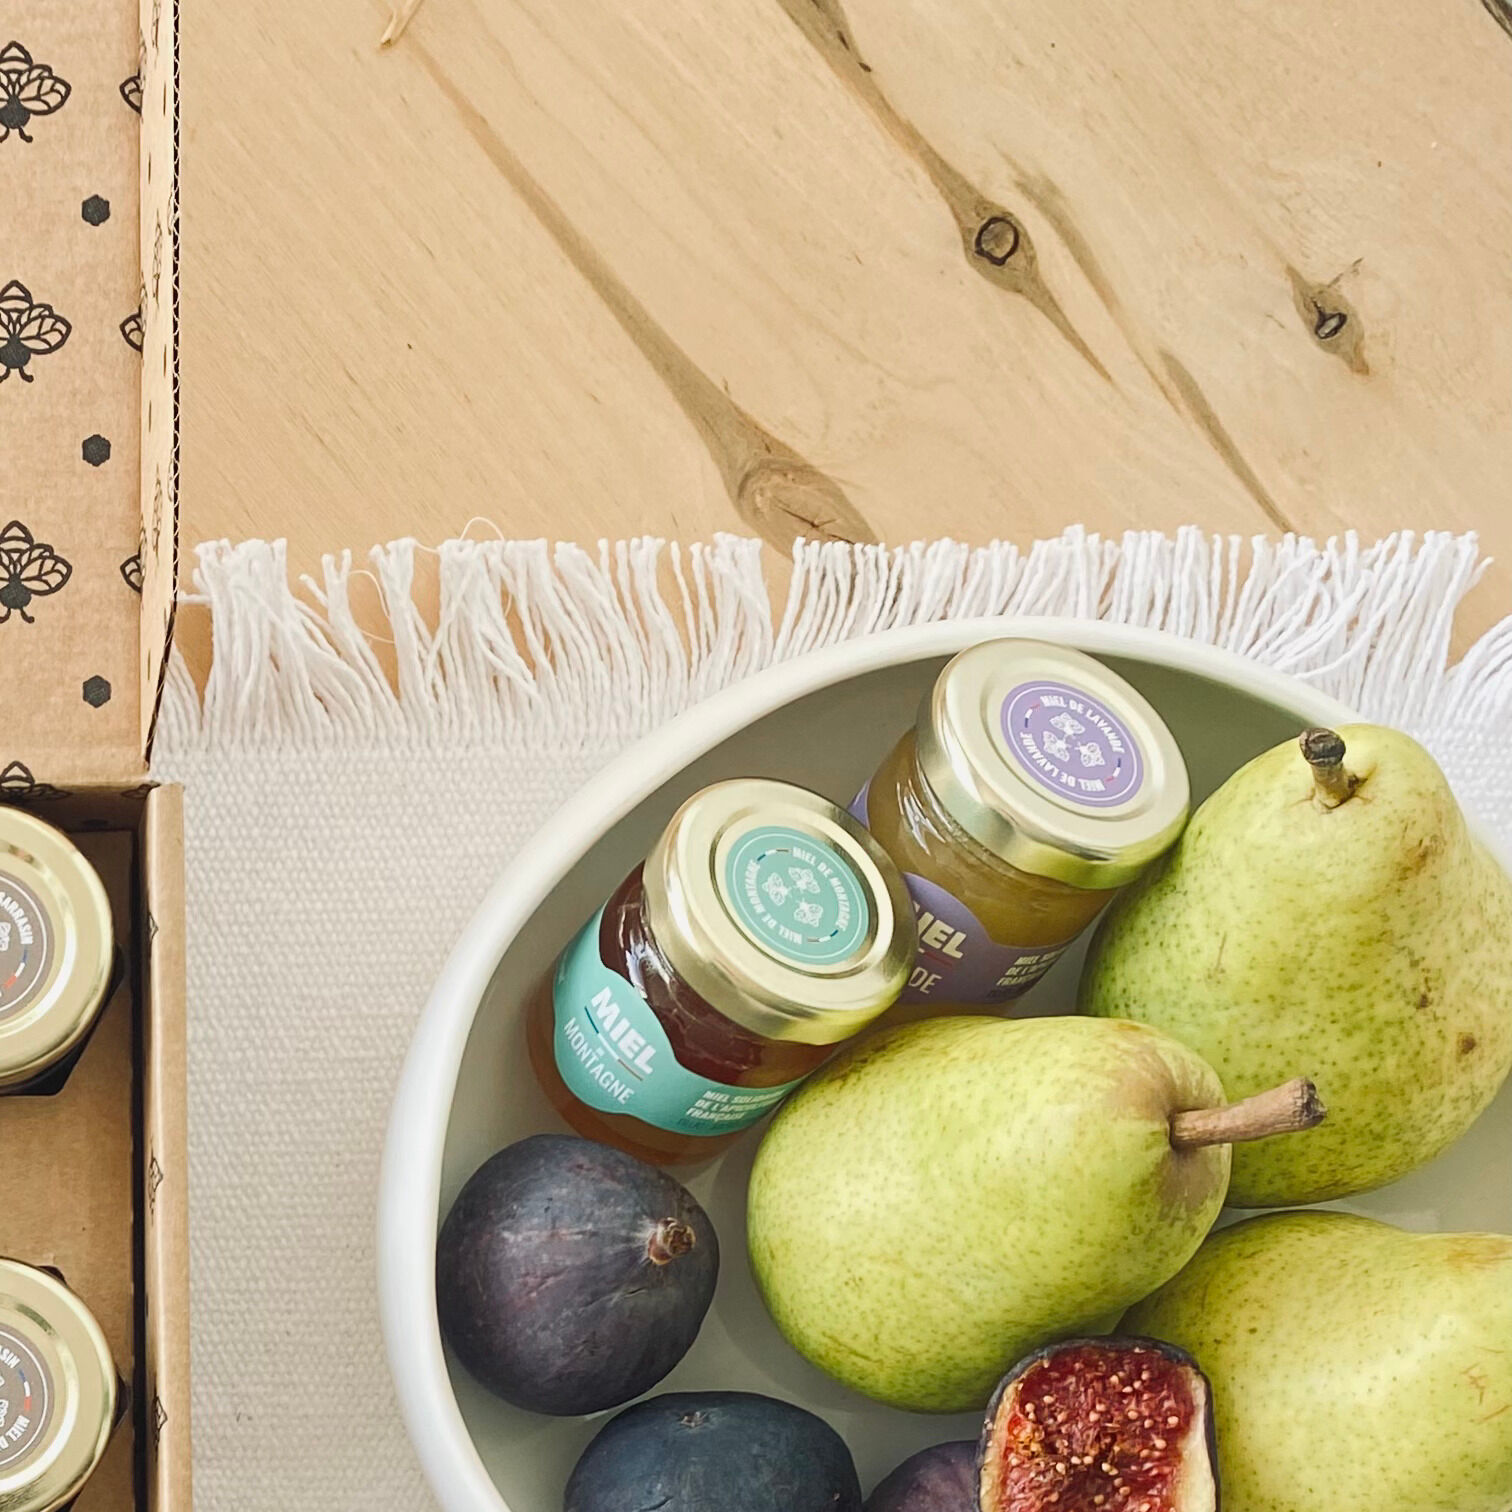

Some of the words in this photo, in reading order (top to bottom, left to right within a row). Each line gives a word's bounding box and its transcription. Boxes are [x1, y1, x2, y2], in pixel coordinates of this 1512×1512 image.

[1040, 696, 1067, 707] MIEL
[1070, 700, 1083, 713] DE
[1086, 710, 1124, 752] LAVANDE
[1020, 732, 1059, 777] LAVANDE
[1060, 772, 1075, 787] DE
[1078, 779, 1105, 791] MIEL
[912, 901, 968, 959] IEL
[591, 986, 657, 1075] MIEL
[564, 1017, 636, 1105] MONTAGNE
[6, 1416, 29, 1441] MIEL
